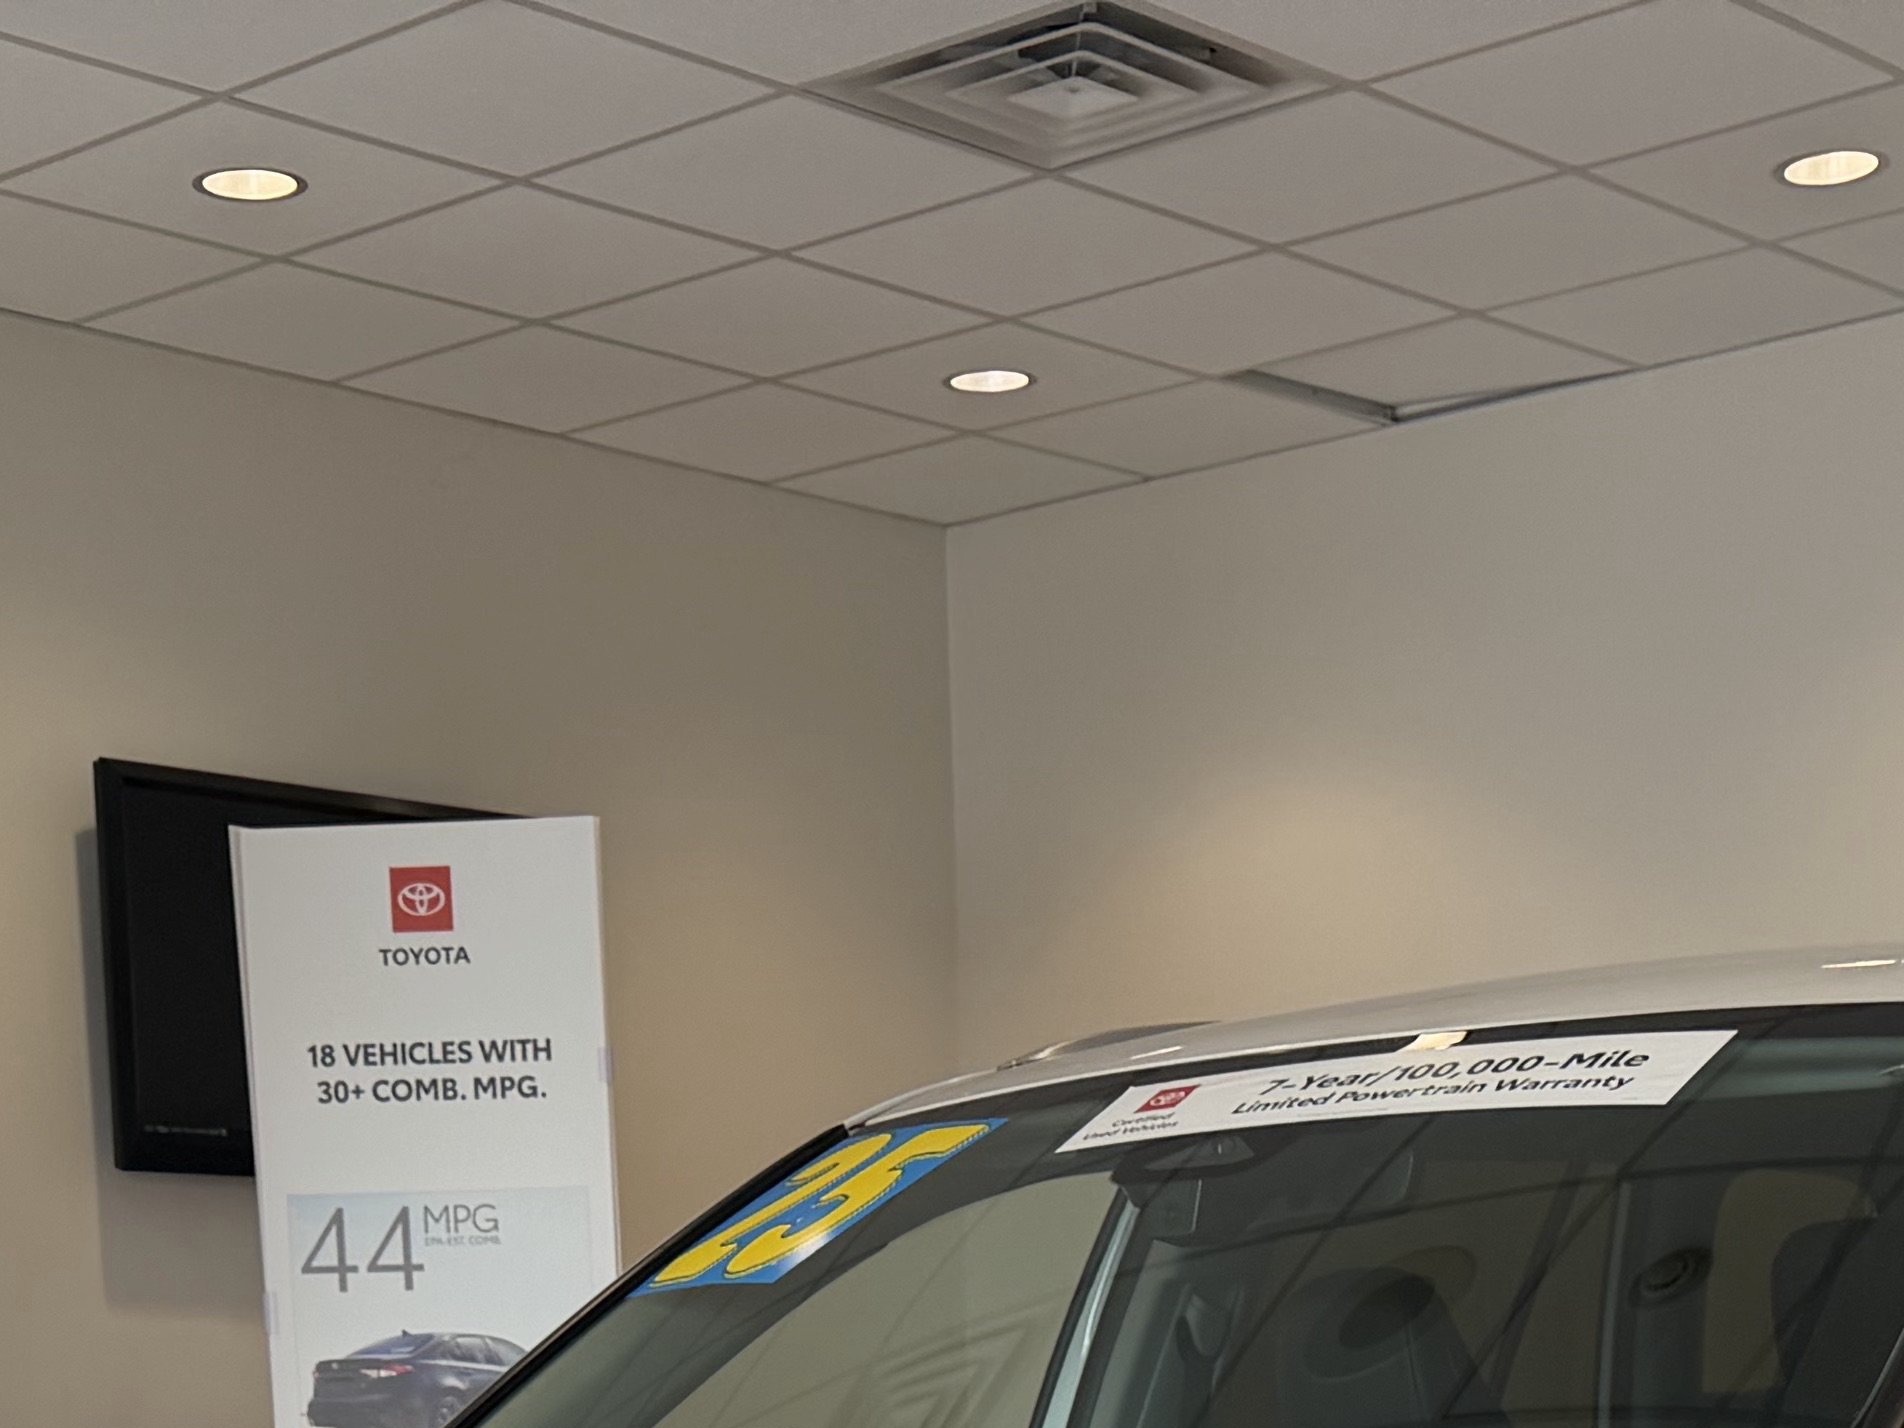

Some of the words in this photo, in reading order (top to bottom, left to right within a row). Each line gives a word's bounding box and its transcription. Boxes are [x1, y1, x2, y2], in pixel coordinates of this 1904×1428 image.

[379, 946, 470, 966] TOYOTA
[306, 1044, 336, 1068] 18
[342, 1040, 473, 1067] VEHICLES
[478, 1038, 553, 1063] WITH
[1259, 1049, 1650, 1096] 7-Year/100,000-Mile
[316, 1080, 366, 1104] 30+
[371, 1078, 468, 1103] COMB.
[473, 1075, 548, 1100] MPG.
[1231, 1091, 1336, 1115] Limited
[1334, 1080, 1488, 1104] Powertrain
[1495, 1075, 1636, 1092] Warranty
[649, 1124, 991, 1288] 25
[301, 1206, 425, 1292] 44
[423, 1203, 500, 1234] MPG
